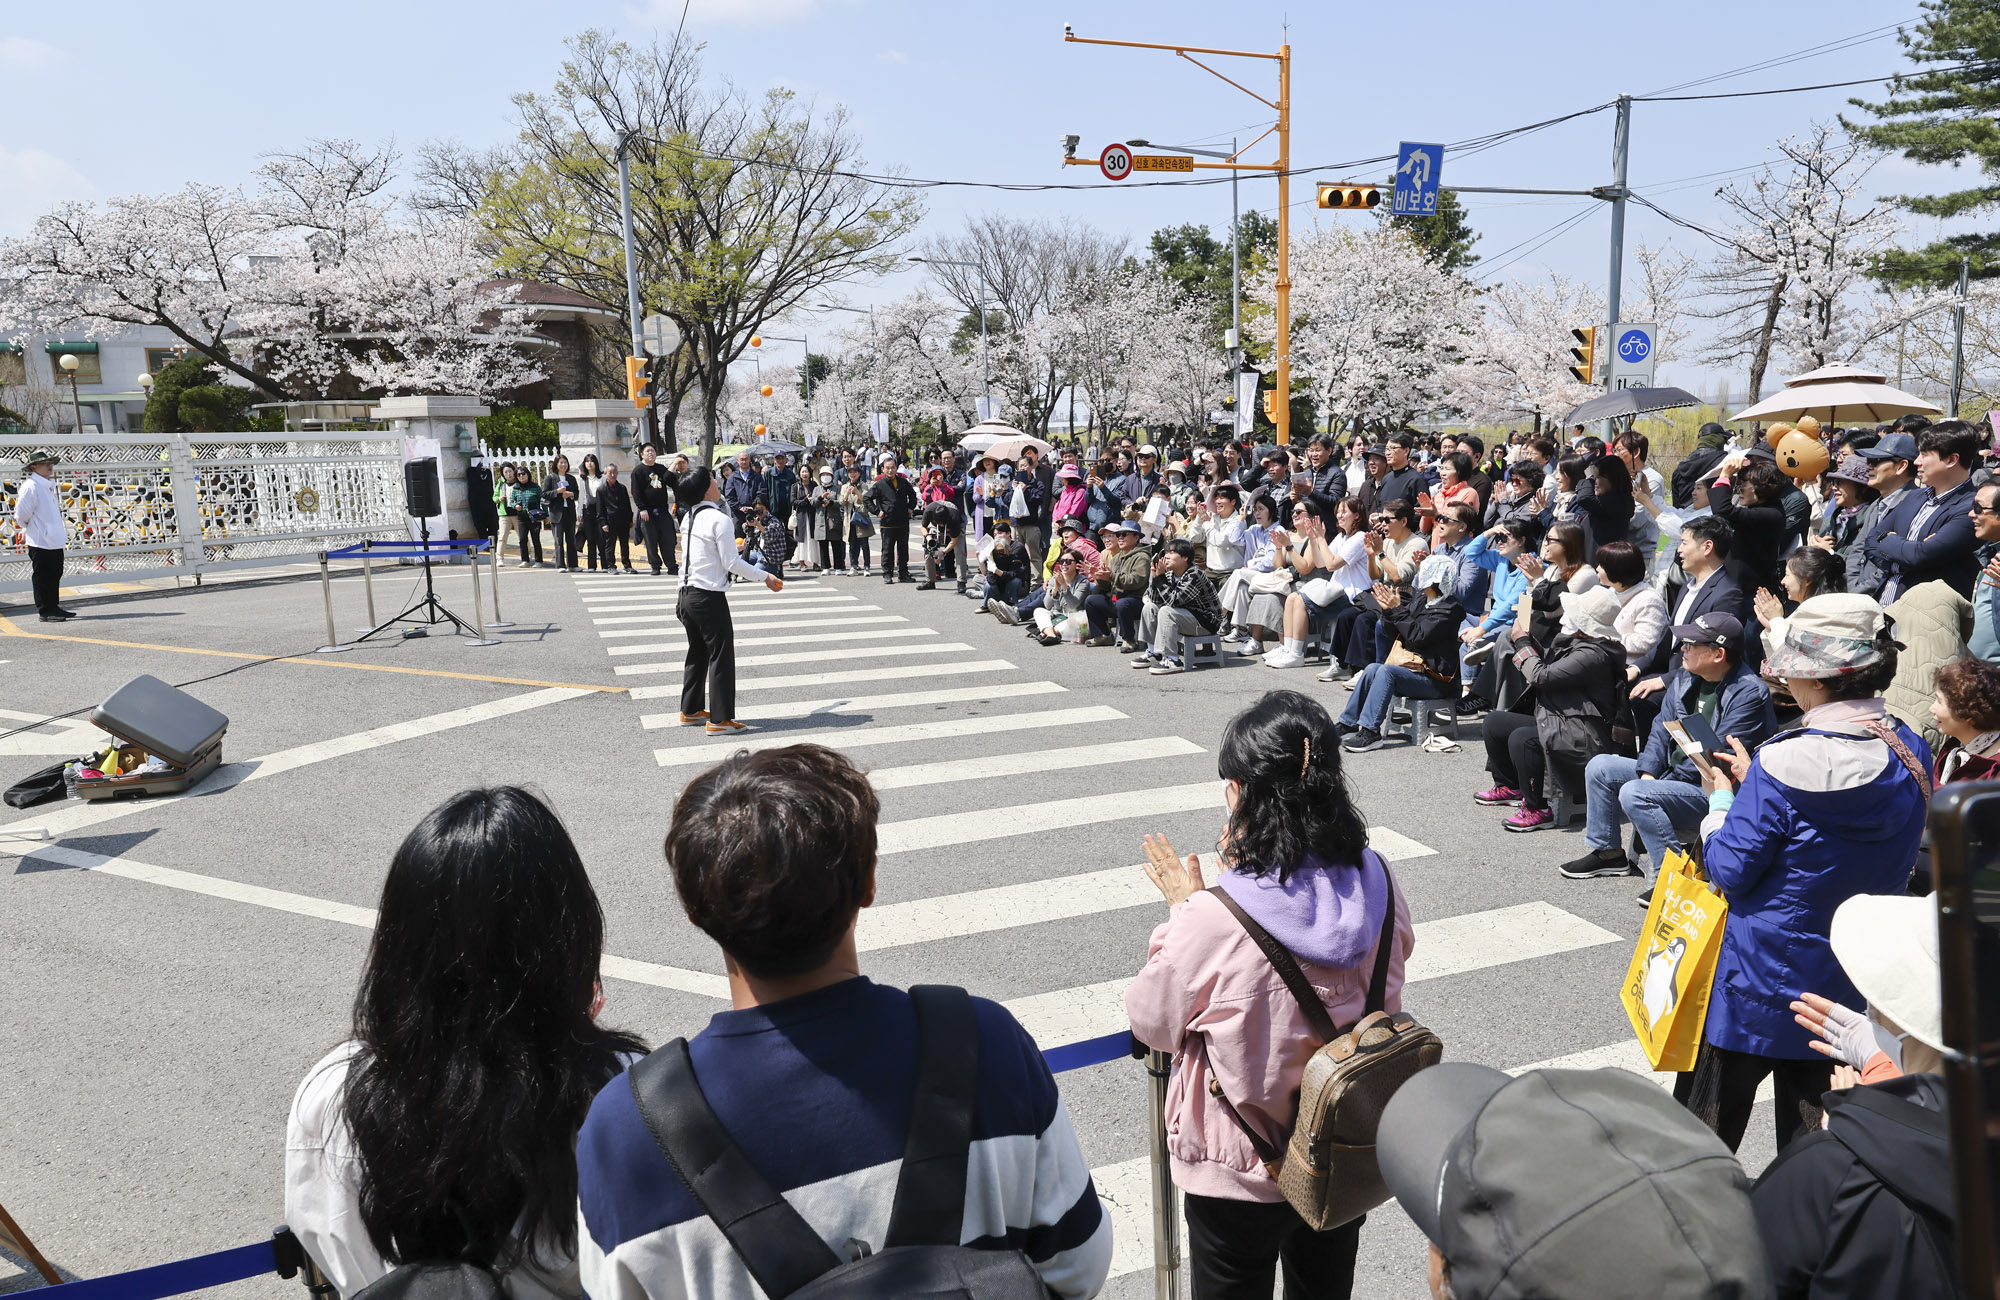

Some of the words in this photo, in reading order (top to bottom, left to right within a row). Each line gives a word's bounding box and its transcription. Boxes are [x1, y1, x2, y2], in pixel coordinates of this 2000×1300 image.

[1107, 154, 1126, 170] 30
[1135, 157, 1149, 169] 신호
[1151, 158, 1192, 170] 과속단속장비
[1395, 189, 1436, 212] 비보호
